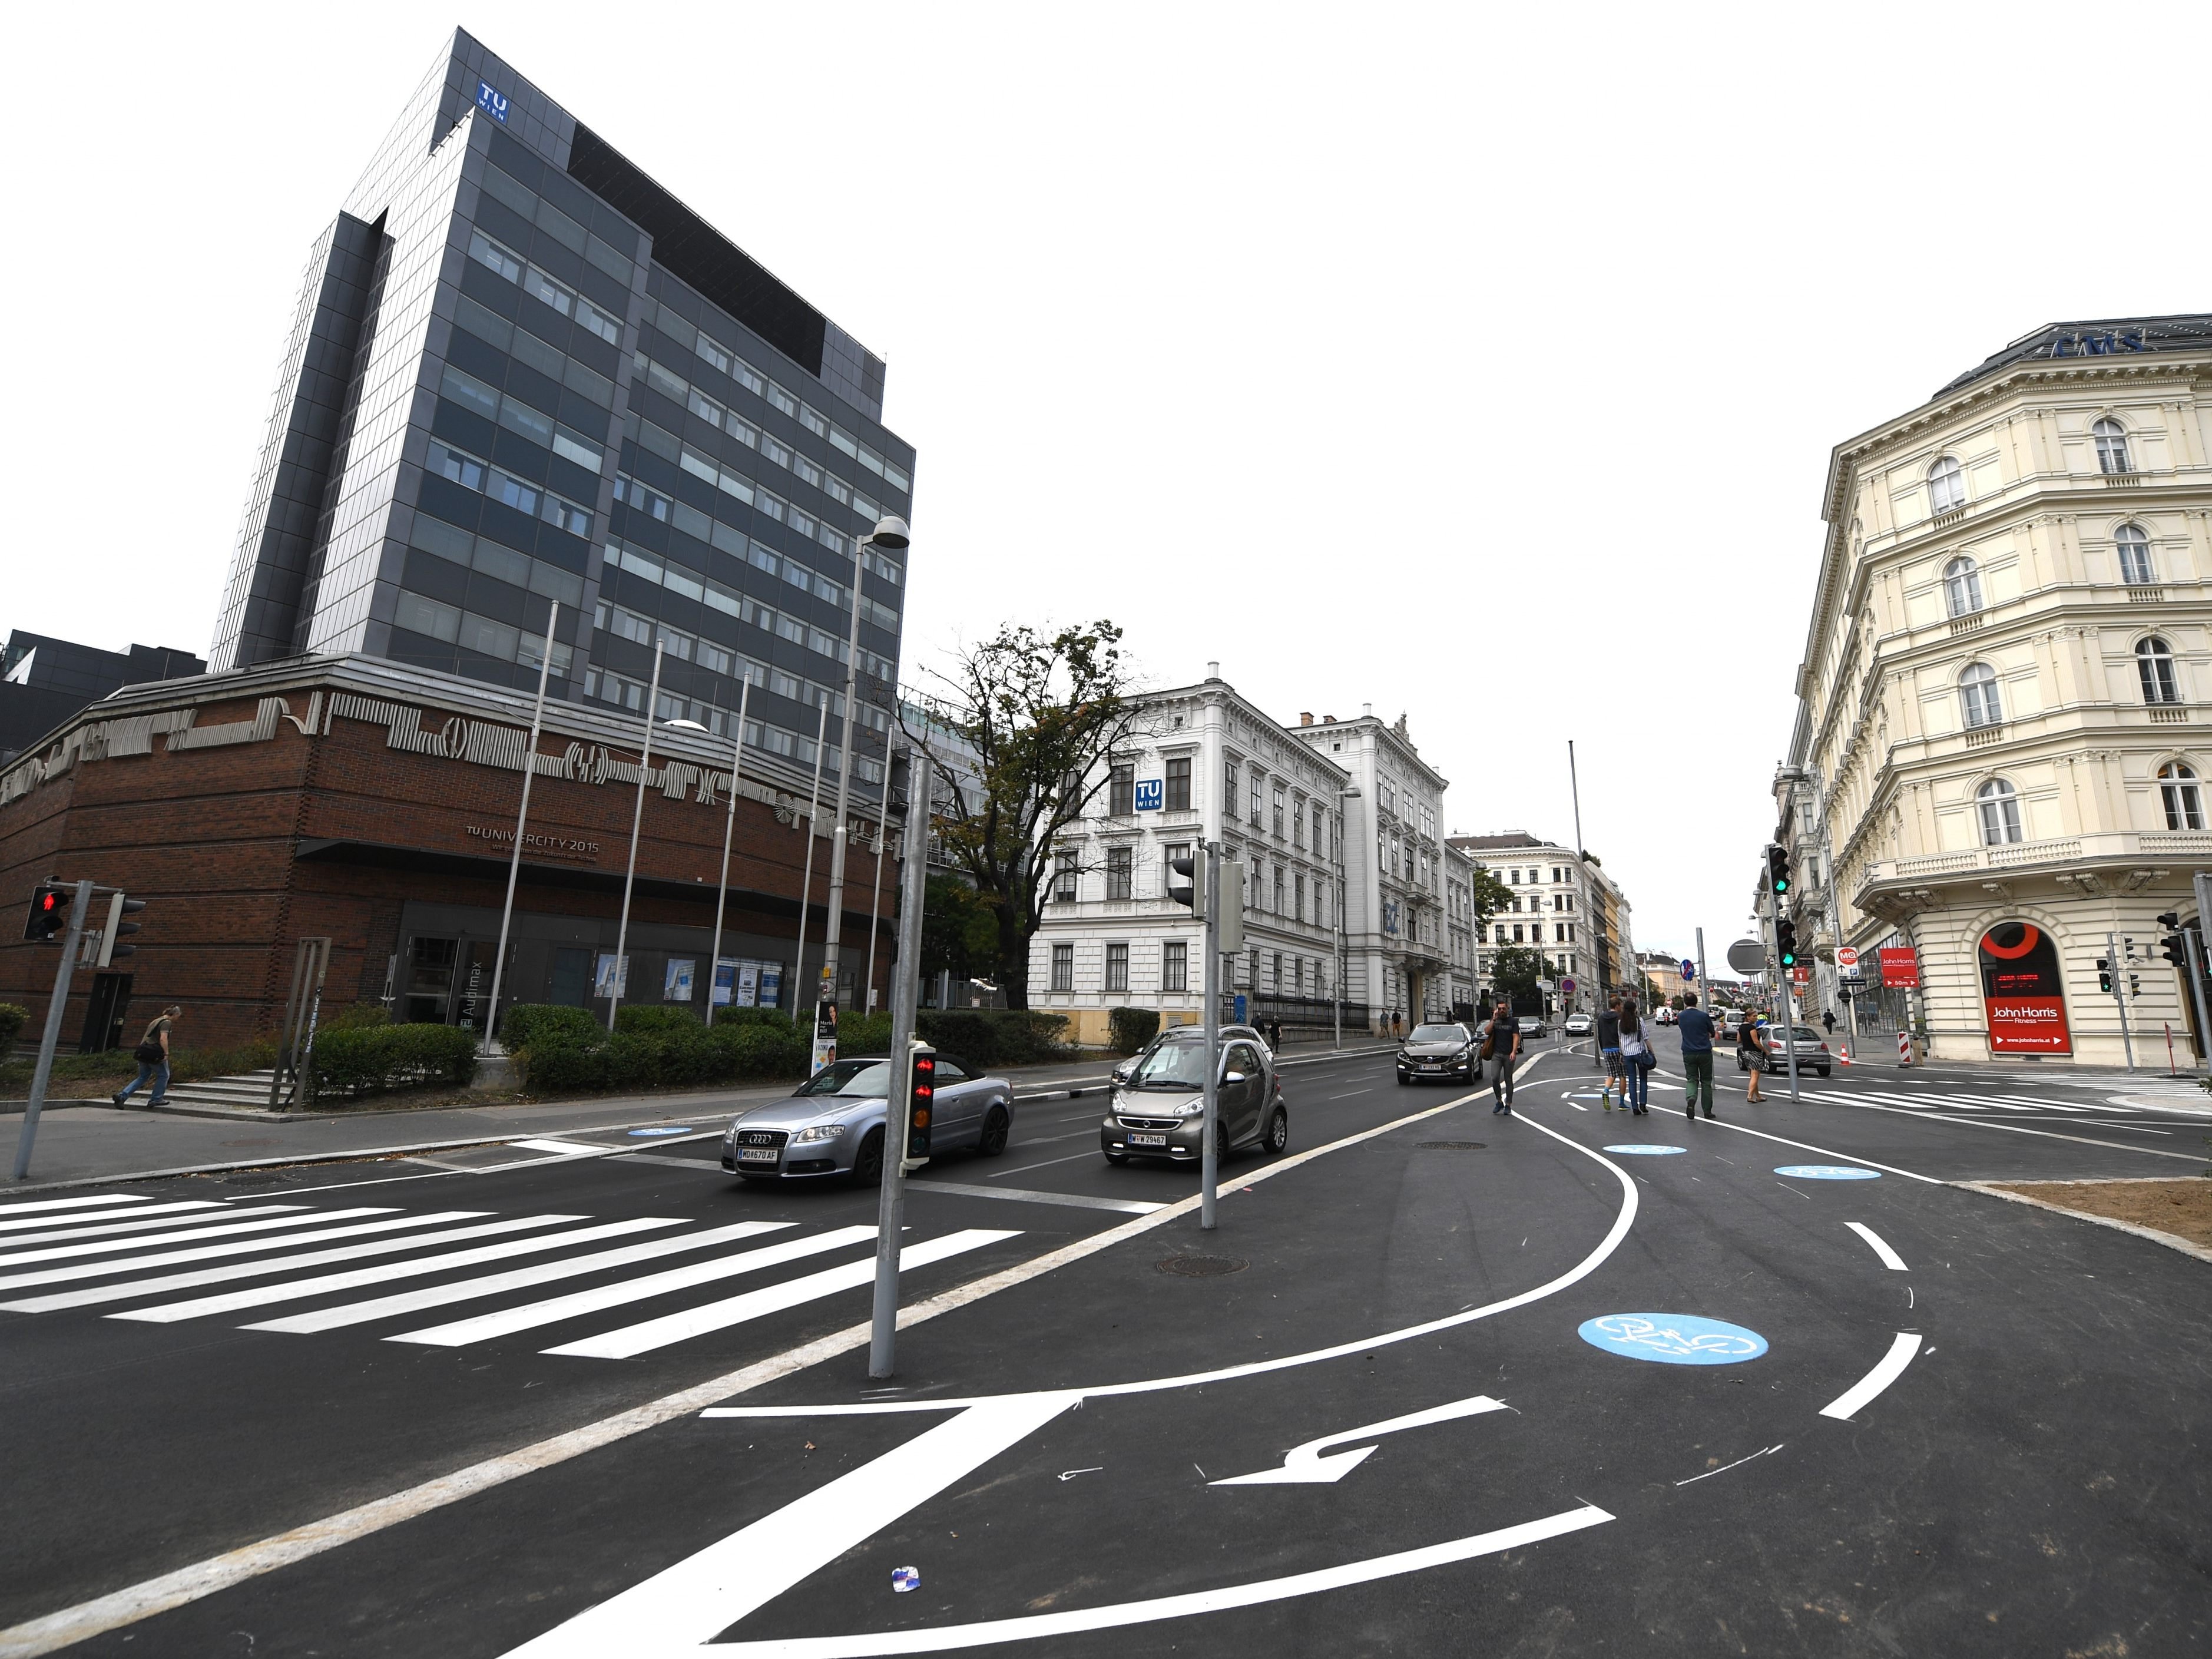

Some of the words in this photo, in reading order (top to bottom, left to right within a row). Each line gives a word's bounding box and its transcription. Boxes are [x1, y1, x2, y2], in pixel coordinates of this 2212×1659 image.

[482, 83, 506, 111] TU
[479, 98, 504, 121] WIEN
[2057, 333, 2144, 357] CMS
[1138, 782, 1160, 798] TU
[466, 826, 480, 835] TU
[482, 828, 567, 848] UNIVERCITY
[569, 840, 599, 853] 2015
[462, 961, 482, 1016] Audimax
[1993, 1006, 2021, 1017] John
[2021, 1006, 2057, 1017] Harris
[754, 1151, 766, 1159] 670
